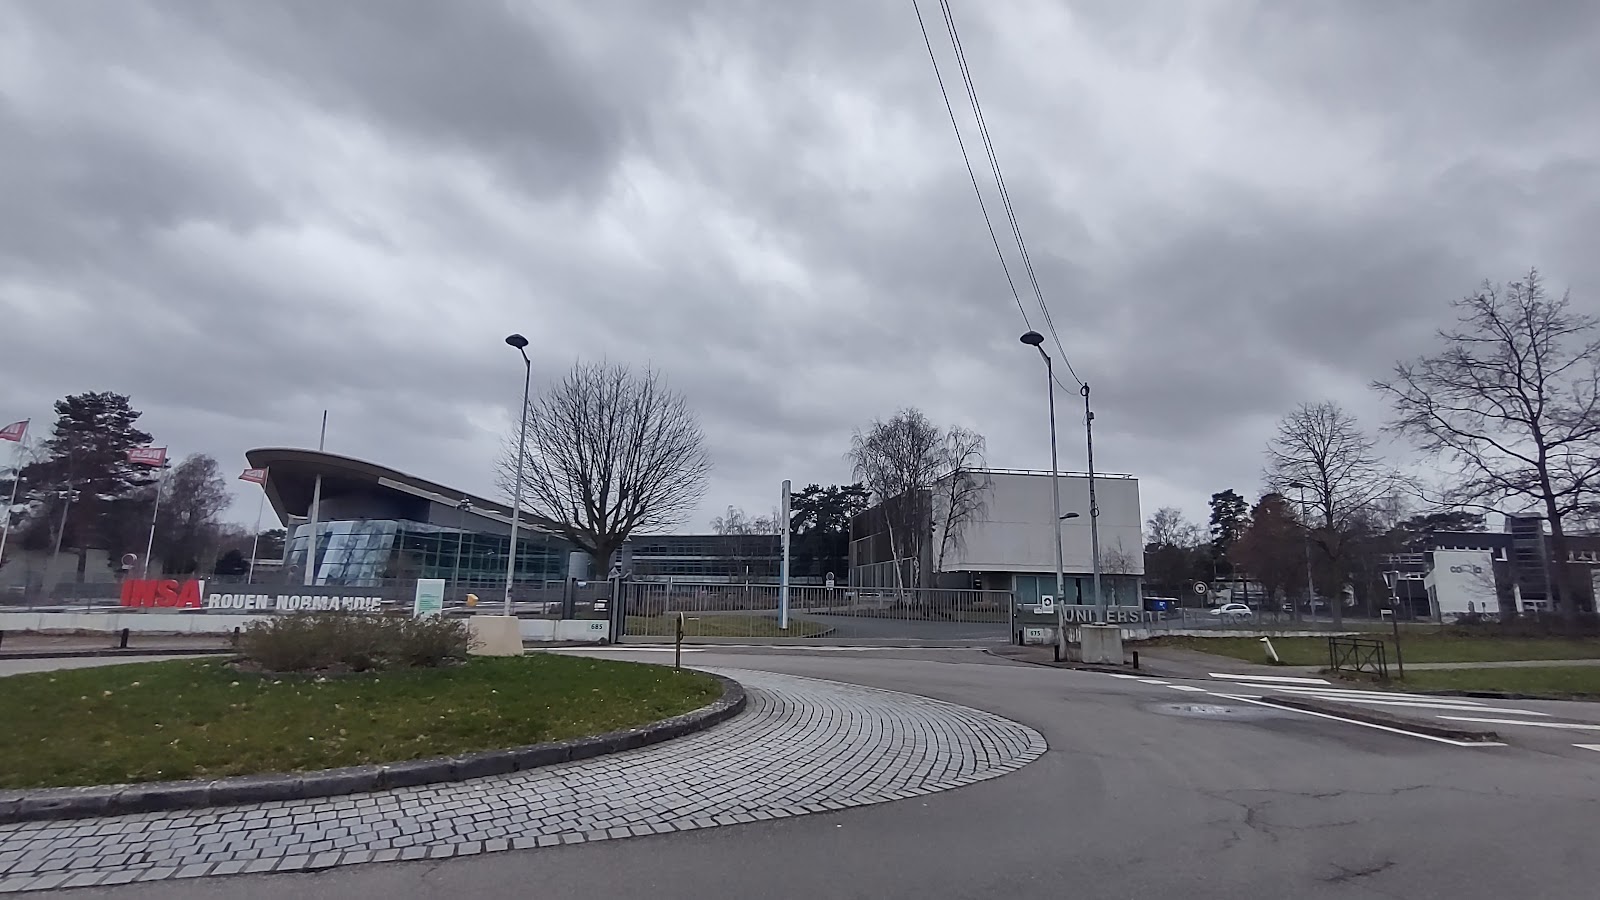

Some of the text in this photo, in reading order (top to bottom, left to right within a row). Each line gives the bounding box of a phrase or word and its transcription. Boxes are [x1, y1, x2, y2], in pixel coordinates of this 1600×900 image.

[121, 579, 382, 611] INSA ROUEN NORMANDIE
[1064, 609, 1167, 623] UNIERSITE
